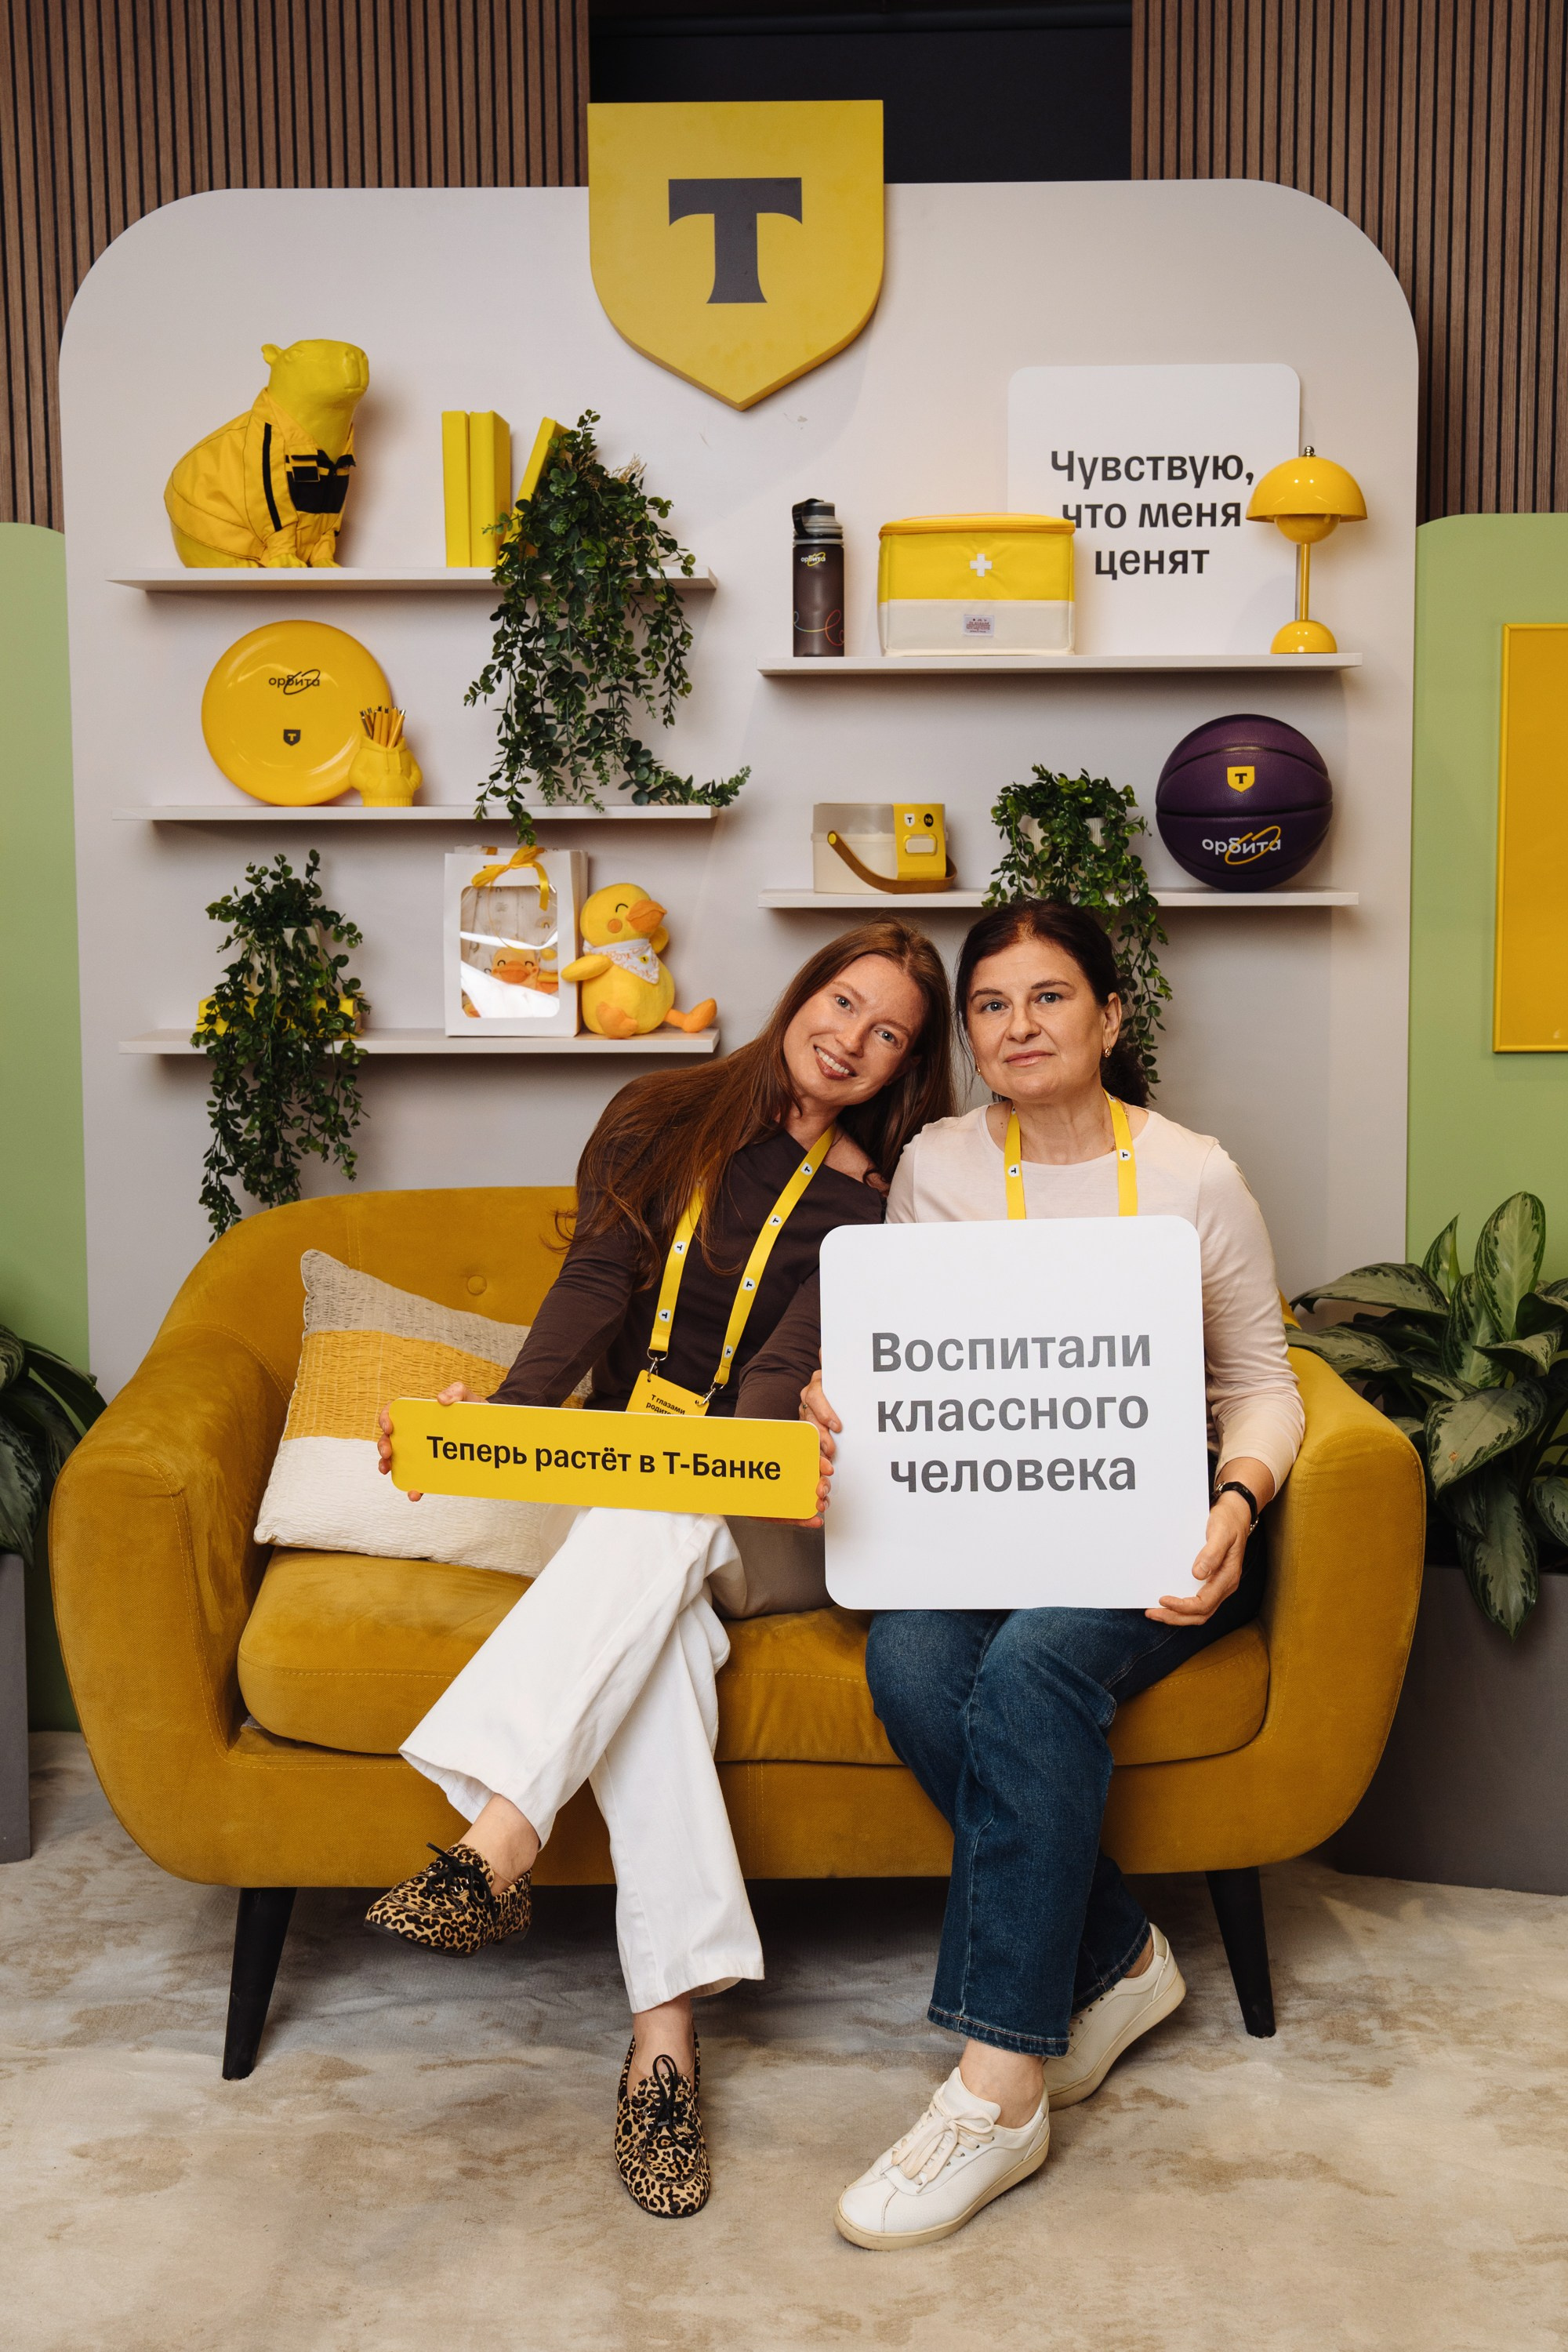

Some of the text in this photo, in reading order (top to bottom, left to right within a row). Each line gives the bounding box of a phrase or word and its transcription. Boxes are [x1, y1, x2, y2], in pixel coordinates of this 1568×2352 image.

[668, 177, 803, 304] Т
[1051, 450, 1254, 490] Чувствую,
[1062, 502, 1241, 528] что меня
[1094, 550, 1210, 581] ценят
[269, 675, 320, 688] орбита
[1235, 772, 1247, 784] Т
[1201, 837, 1282, 856] орбита
[872, 1332, 1151, 1373] Воспитали
[655, 1397, 685, 1415] глазами
[877, 1395, 1149, 1433] классного
[426, 1436, 781, 1481] Теперь растёт в Т-Банке
[891, 1457, 1136, 1494] человека
